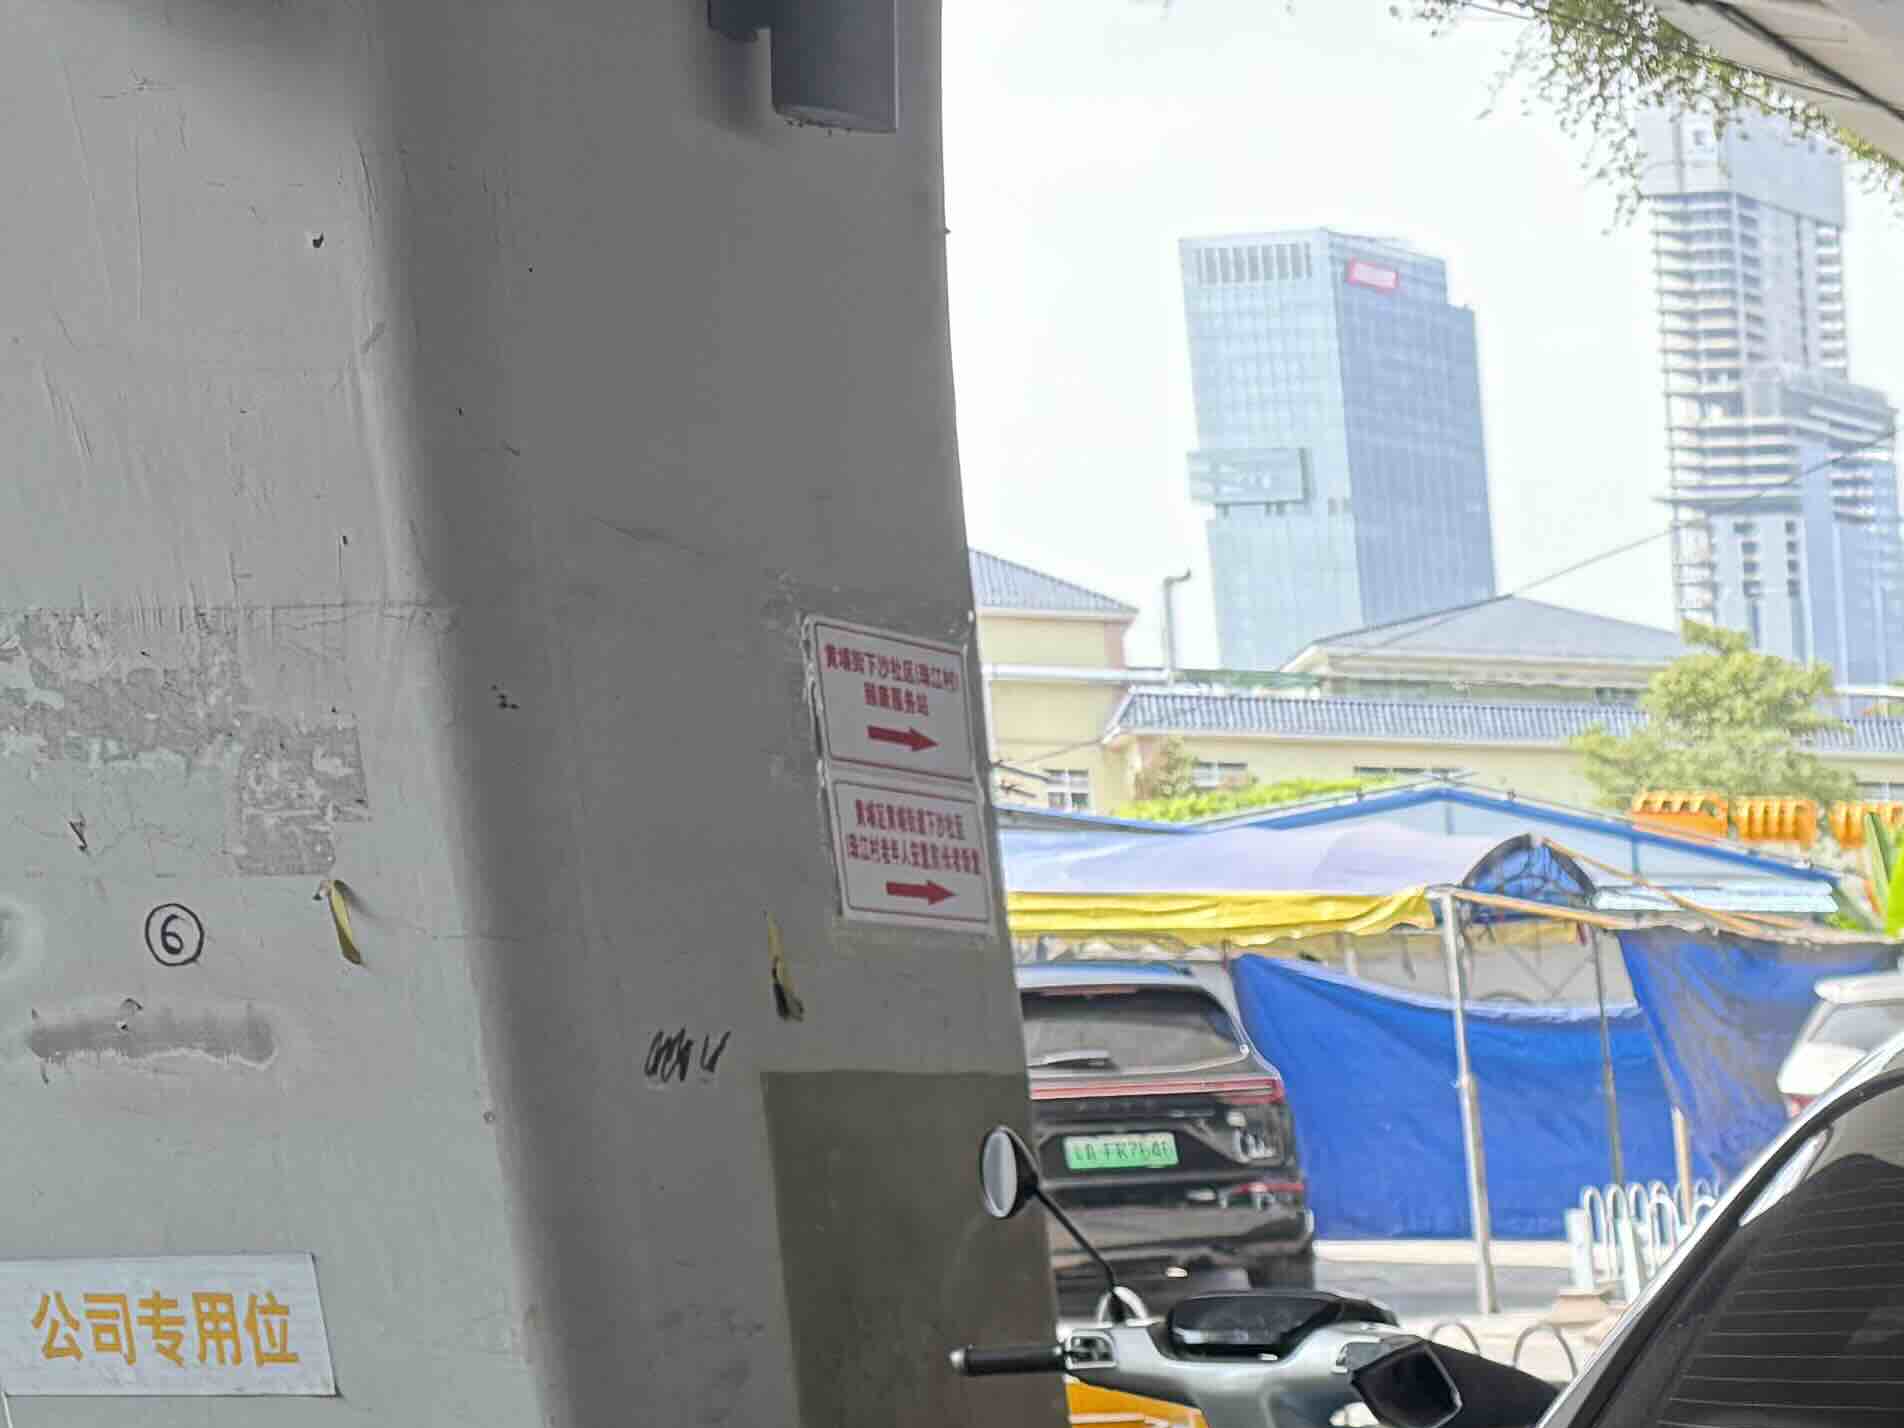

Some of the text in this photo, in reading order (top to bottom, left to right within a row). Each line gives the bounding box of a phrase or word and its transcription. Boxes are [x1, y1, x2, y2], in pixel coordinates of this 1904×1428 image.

[32, 1290, 299, 1367] 公司专用位
